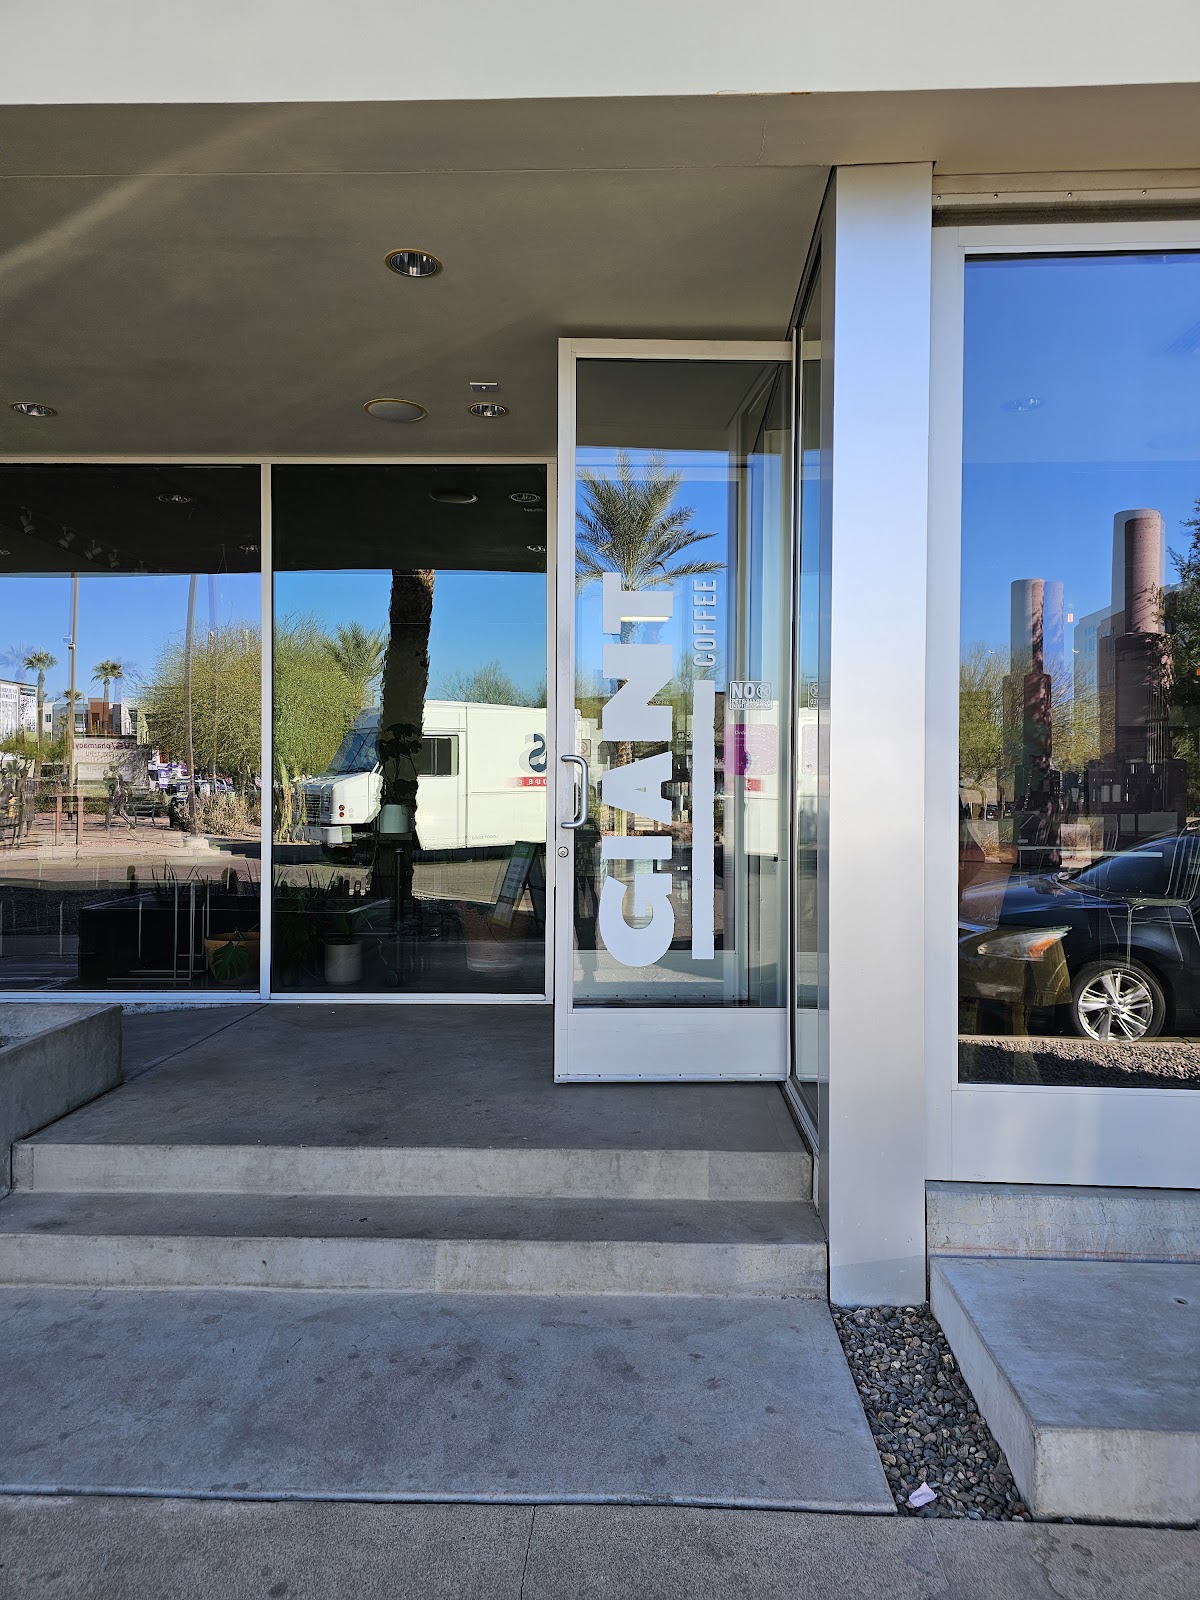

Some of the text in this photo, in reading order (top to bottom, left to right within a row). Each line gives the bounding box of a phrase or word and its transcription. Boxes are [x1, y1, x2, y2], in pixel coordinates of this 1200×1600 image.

[693, 579, 717, 667] COFFEE
[731, 682, 756, 699] NO
[599, 572, 675, 967] GIANT
